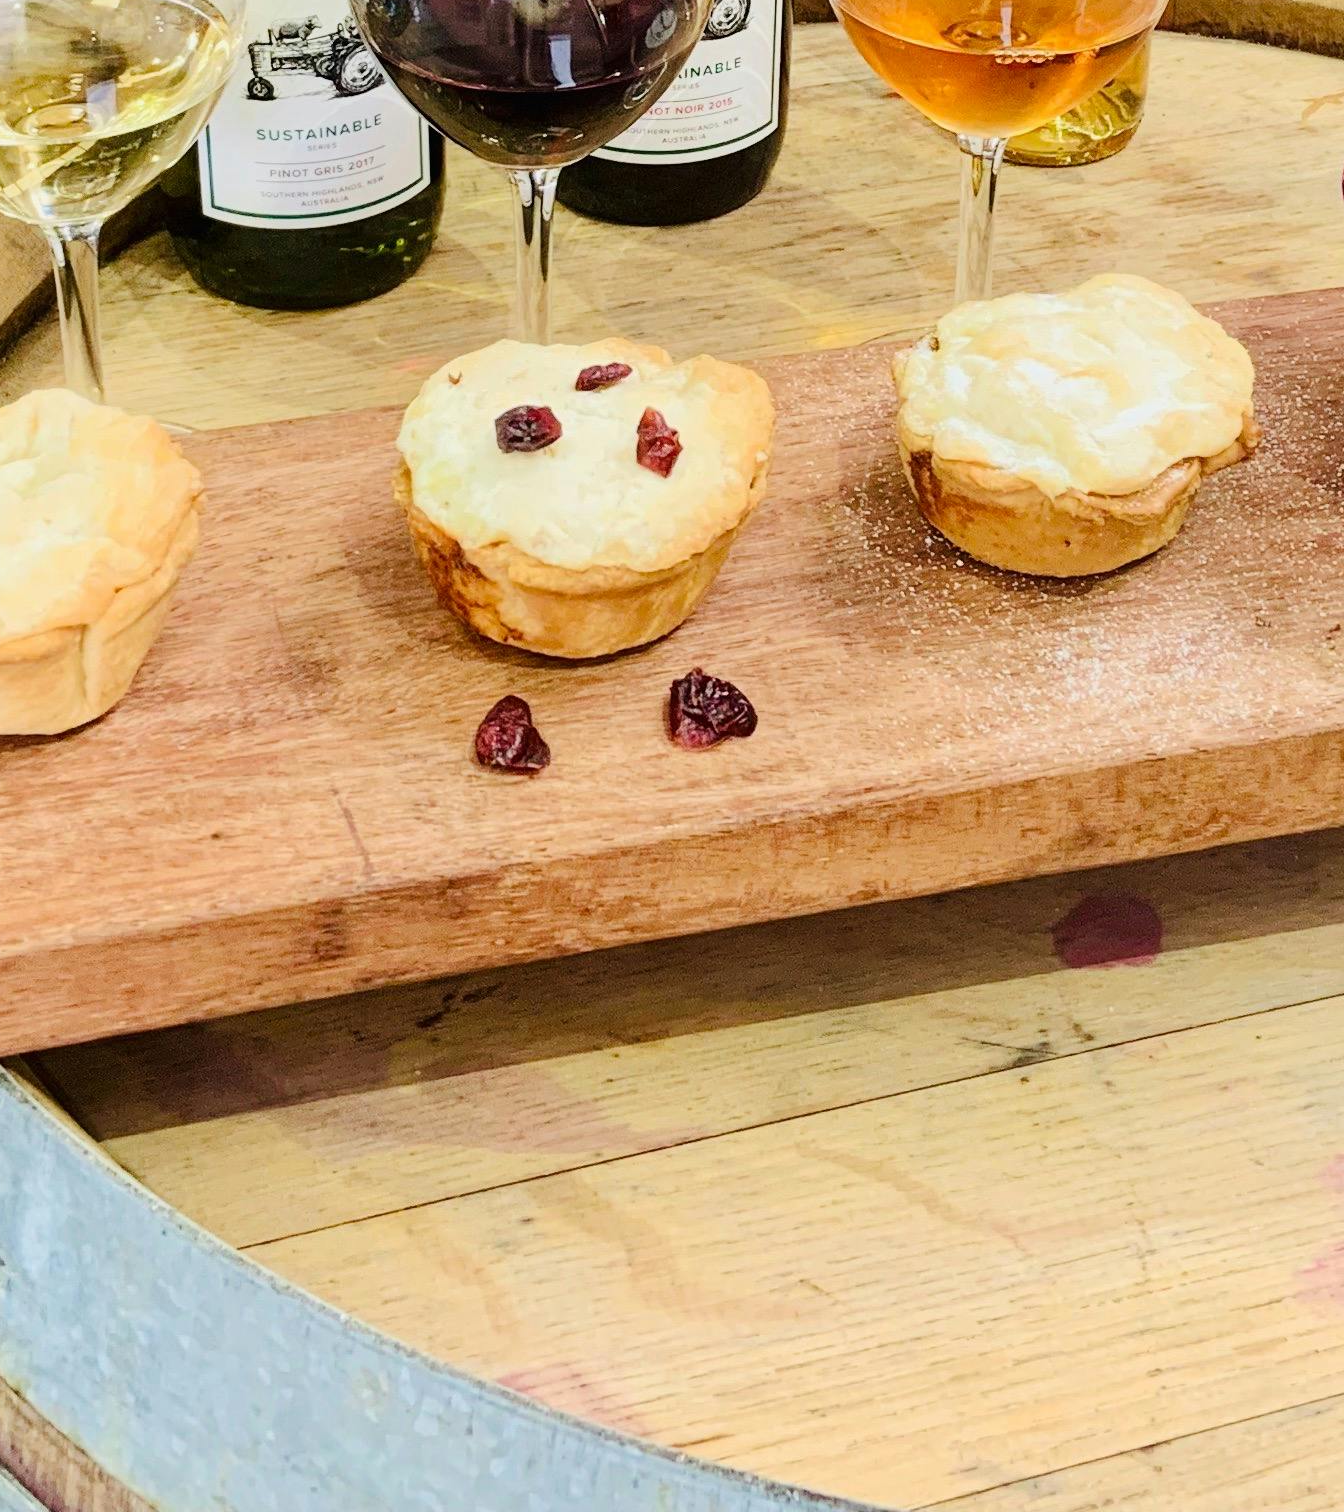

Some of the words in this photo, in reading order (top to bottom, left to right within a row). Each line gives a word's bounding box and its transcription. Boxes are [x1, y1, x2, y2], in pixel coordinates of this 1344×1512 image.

[675, 103, 705, 116] NOIR
[256, 113, 383, 142] SUSTAINABLE
[269, 168, 309, 179] PINOT
[313, 163, 345, 177] GRIS
[348, 155, 376, 171] 2017
[260, 190, 310, 199] SOUTHERN
[300, 195, 350, 208] AUSTRALIA
